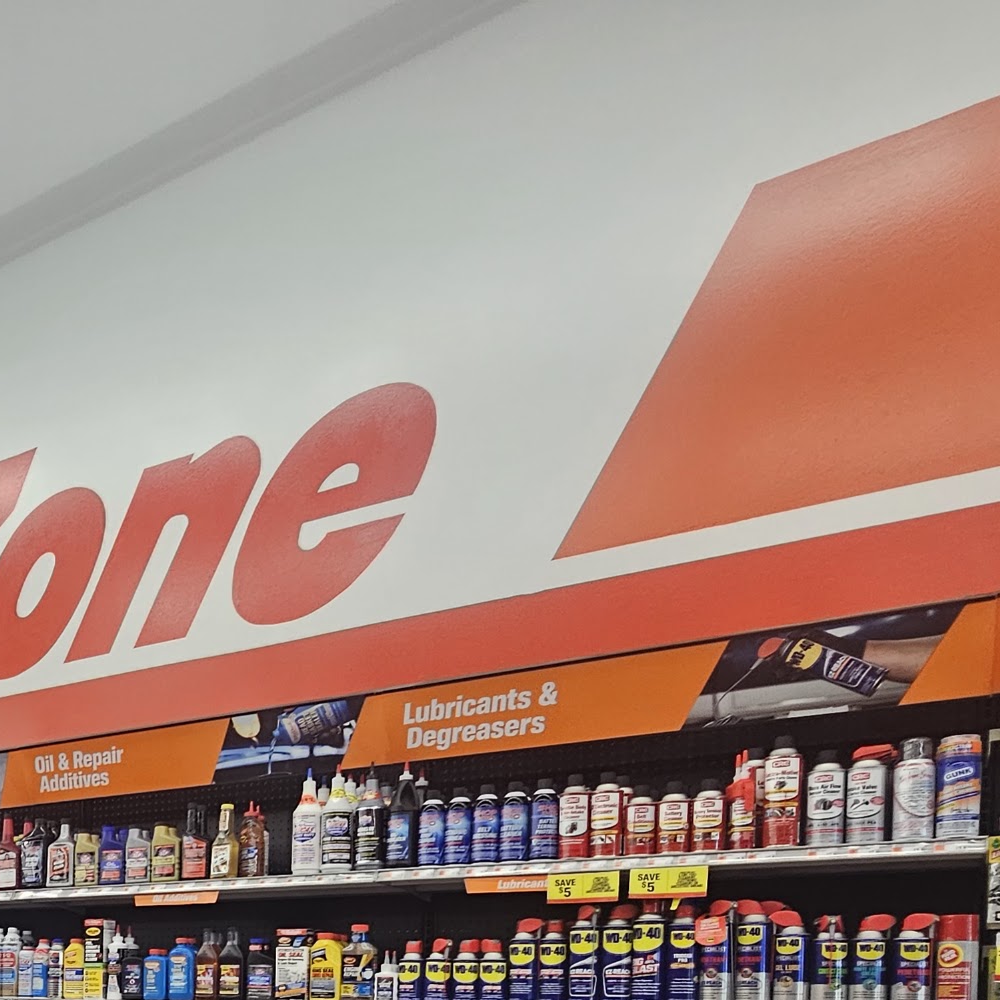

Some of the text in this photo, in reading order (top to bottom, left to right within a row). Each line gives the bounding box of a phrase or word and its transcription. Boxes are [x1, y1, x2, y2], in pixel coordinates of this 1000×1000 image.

[403, 682, 558, 725] Lubricants &
[407, 715, 546, 750] Degreasers
[34, 746, 124, 774] Oil & Repair
[945, 769, 971, 780] GUNK
[39, 771, 110, 793] Additives
[637, 873, 660, 881] SAVE
[555, 879, 576, 887] SAVE
[642, 881, 655, 892] $5
[559, 887, 571, 898] $5
[673, 931, 695, 940] WD-40
[738, 927, 761, 937] WD-40
[571, 933, 598, 943] WD-40
[605, 932, 632, 943] WD-40
[778, 938, 800, 947] WD-40
[511, 946, 533, 955] WD-40
[540, 946, 565, 955] WD-40
[860, 943, 884, 952] WD-40
[904, 943, 928, 953] WD-40
[426, 964, 450, 974] WD-40
[454, 964, 478, 974] WD-40
[482, 964, 505, 974] WD-40
